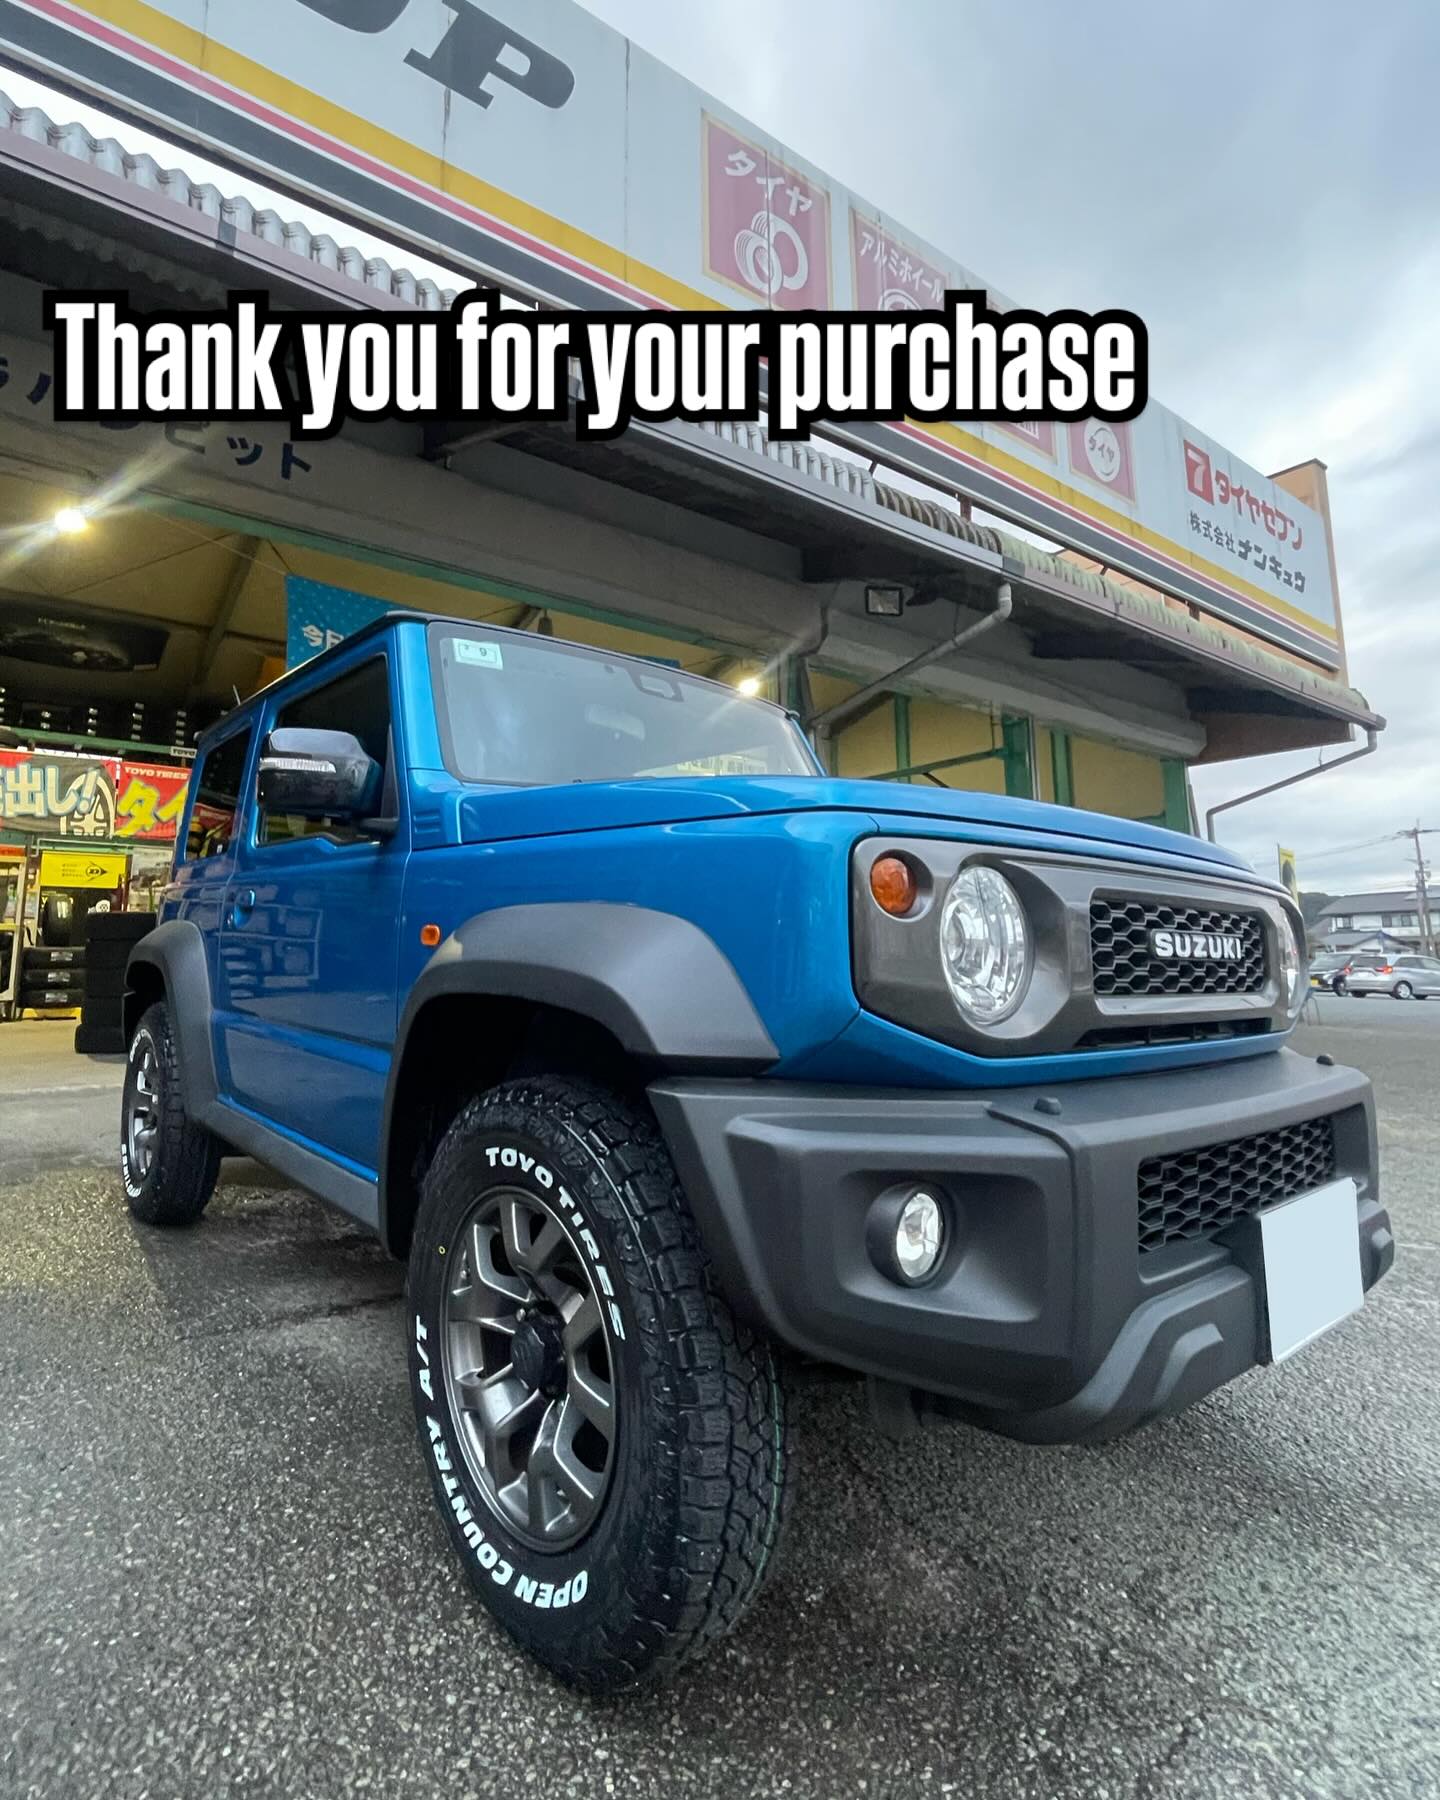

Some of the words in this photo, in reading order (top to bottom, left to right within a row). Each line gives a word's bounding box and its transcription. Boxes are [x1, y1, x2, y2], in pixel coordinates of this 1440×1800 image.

[293, 0, 576, 110] P
[724, 150, 812, 216] タイヤ
[860, 231, 944, 303] アルミホイール
[1215, 469, 1303, 551] タイヤセブン
[0, 762, 100, 817] 出し!
[124, 766, 155, 777] TOYO
[156, 769, 189, 780] TIRES
[1154, 932, 1242, 960] SUZUKI
[485, 1146, 554, 1189] TOYO
[558, 1185, 627, 1341] TIRES
[415, 1314, 434, 1401] A/T
[426, 1415, 515, 1586] COUNTRY
[513, 1569, 588, 1609] OPEN
